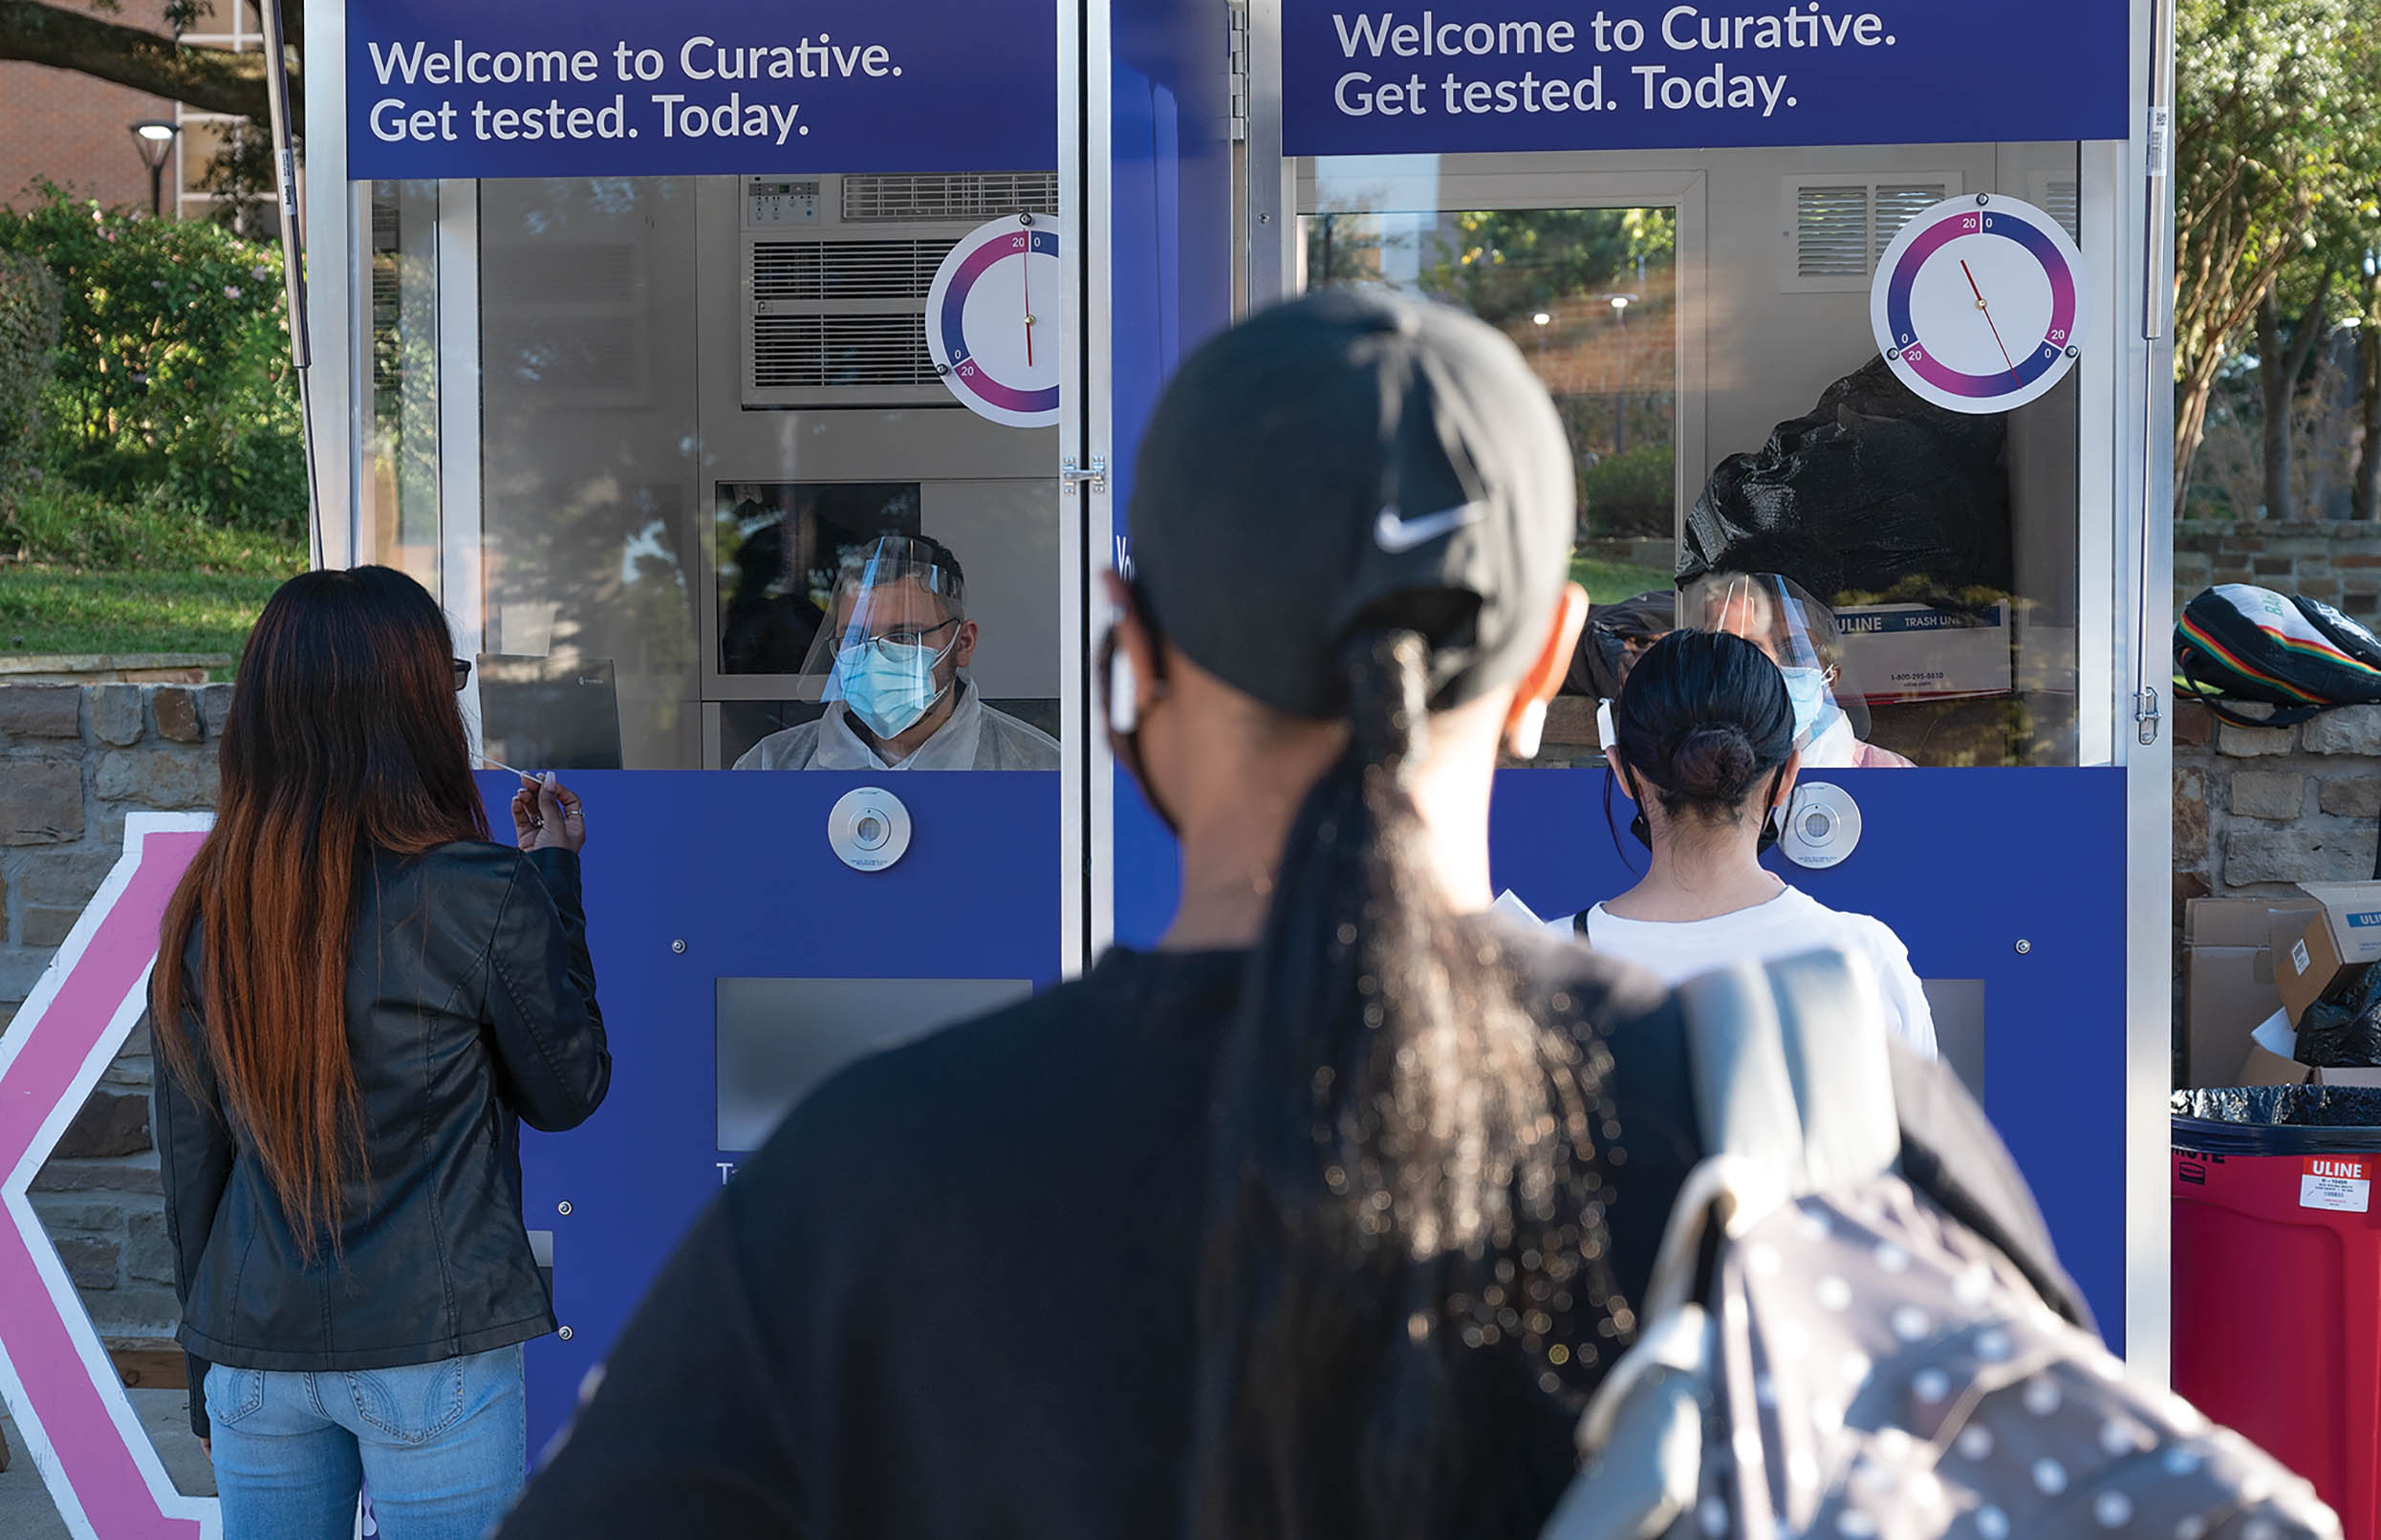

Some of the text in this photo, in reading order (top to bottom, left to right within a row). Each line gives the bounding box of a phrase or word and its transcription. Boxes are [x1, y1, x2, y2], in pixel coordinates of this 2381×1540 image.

[1331, 1, 1897, 57] Welcome to Curative.
[367, 33, 902, 85] Welcome to Curative.
[1334, 62, 1798, 118] Get tested. Today.
[369, 92, 809, 145] Get tested. Today.
[1962, 217, 1977, 228] 20
[1985, 217, 1993, 228] 0
[1011, 236, 1025, 248] 20
[1033, 236, 1041, 248] 0
[1901, 333, 1909, 344] 0
[2050, 329, 2066, 340] 20
[954, 349, 962, 360] 0
[1908, 350, 1922, 361] 20
[2045, 348, 2051, 358] 0
[961, 366, 974, 377] 20
[1835, 617, 1882, 632] ULINE
[1904, 616, 1937, 627] TRASH
[2313, 1160, 2363, 1179] ULINE
